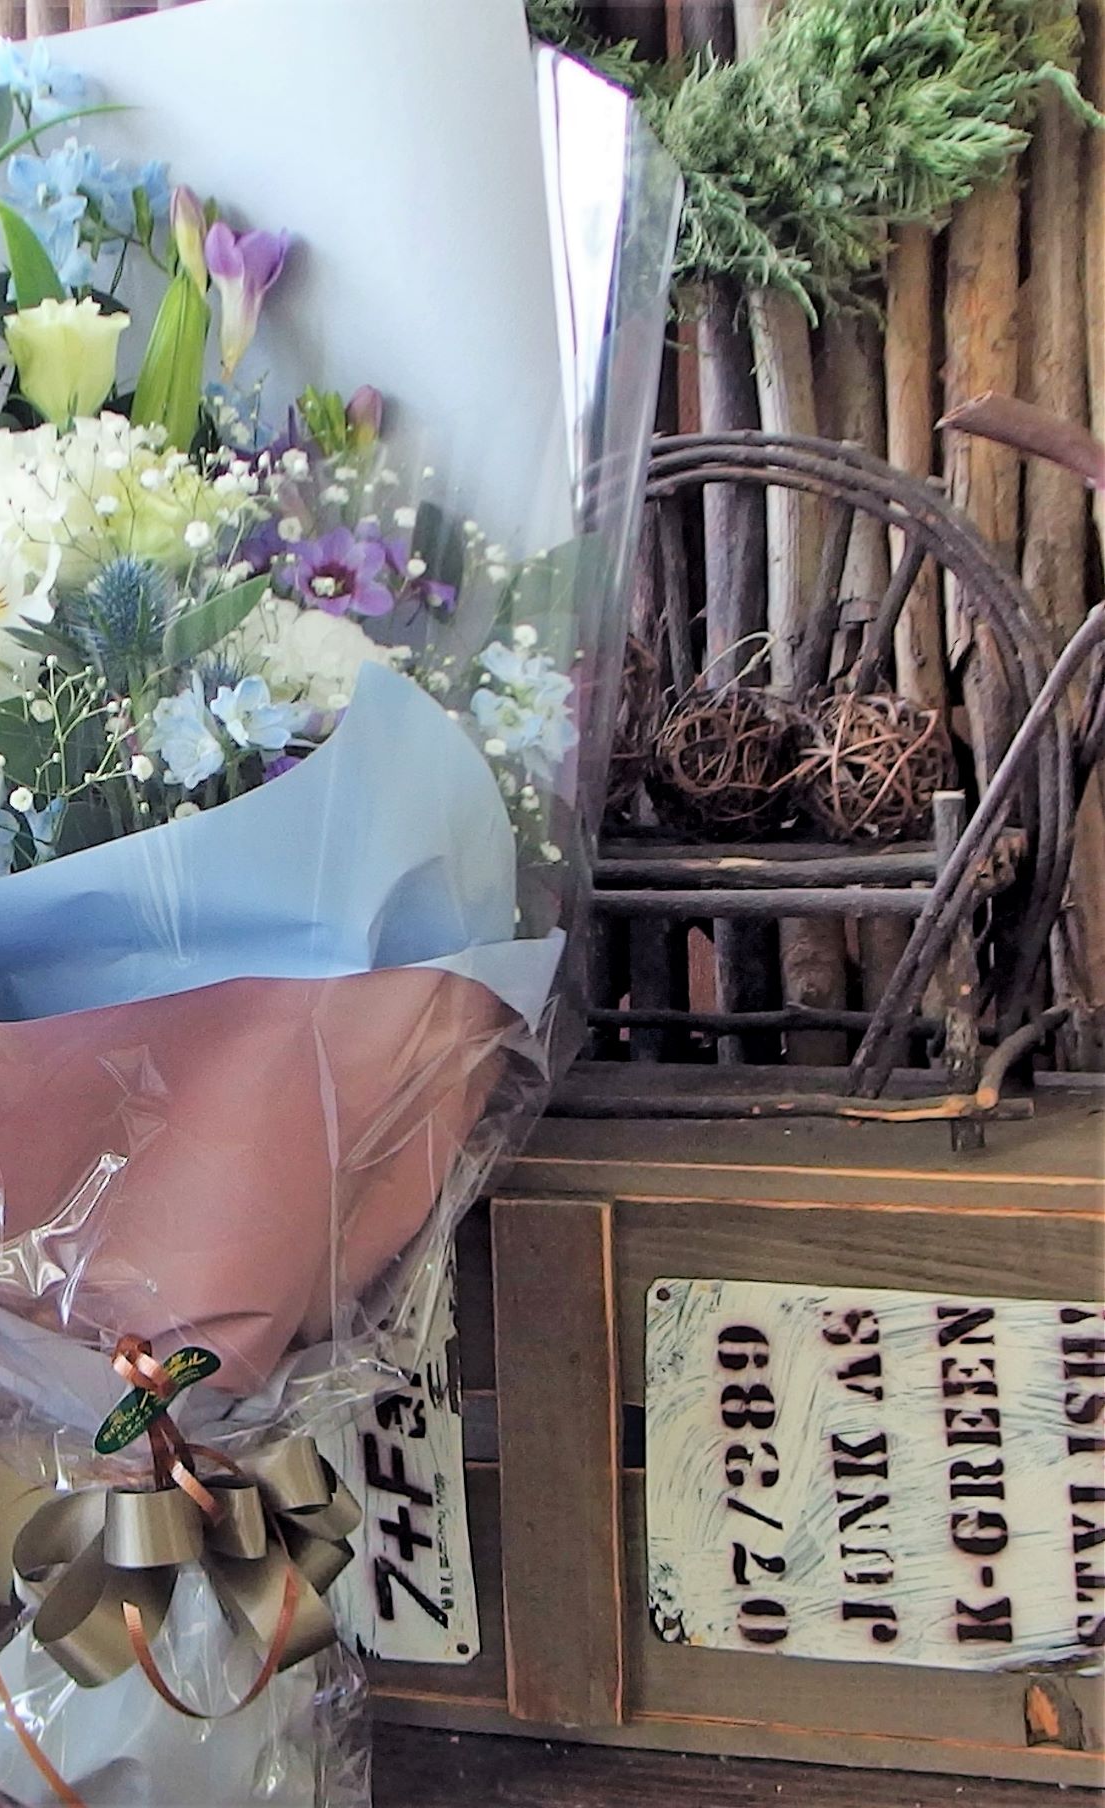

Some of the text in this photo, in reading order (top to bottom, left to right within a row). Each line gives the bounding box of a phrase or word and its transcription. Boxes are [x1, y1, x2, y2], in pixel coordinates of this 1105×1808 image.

[822, 1309, 897, 1644] JUNK AS
[936, 1306, 1012, 1643] K-GREEN
